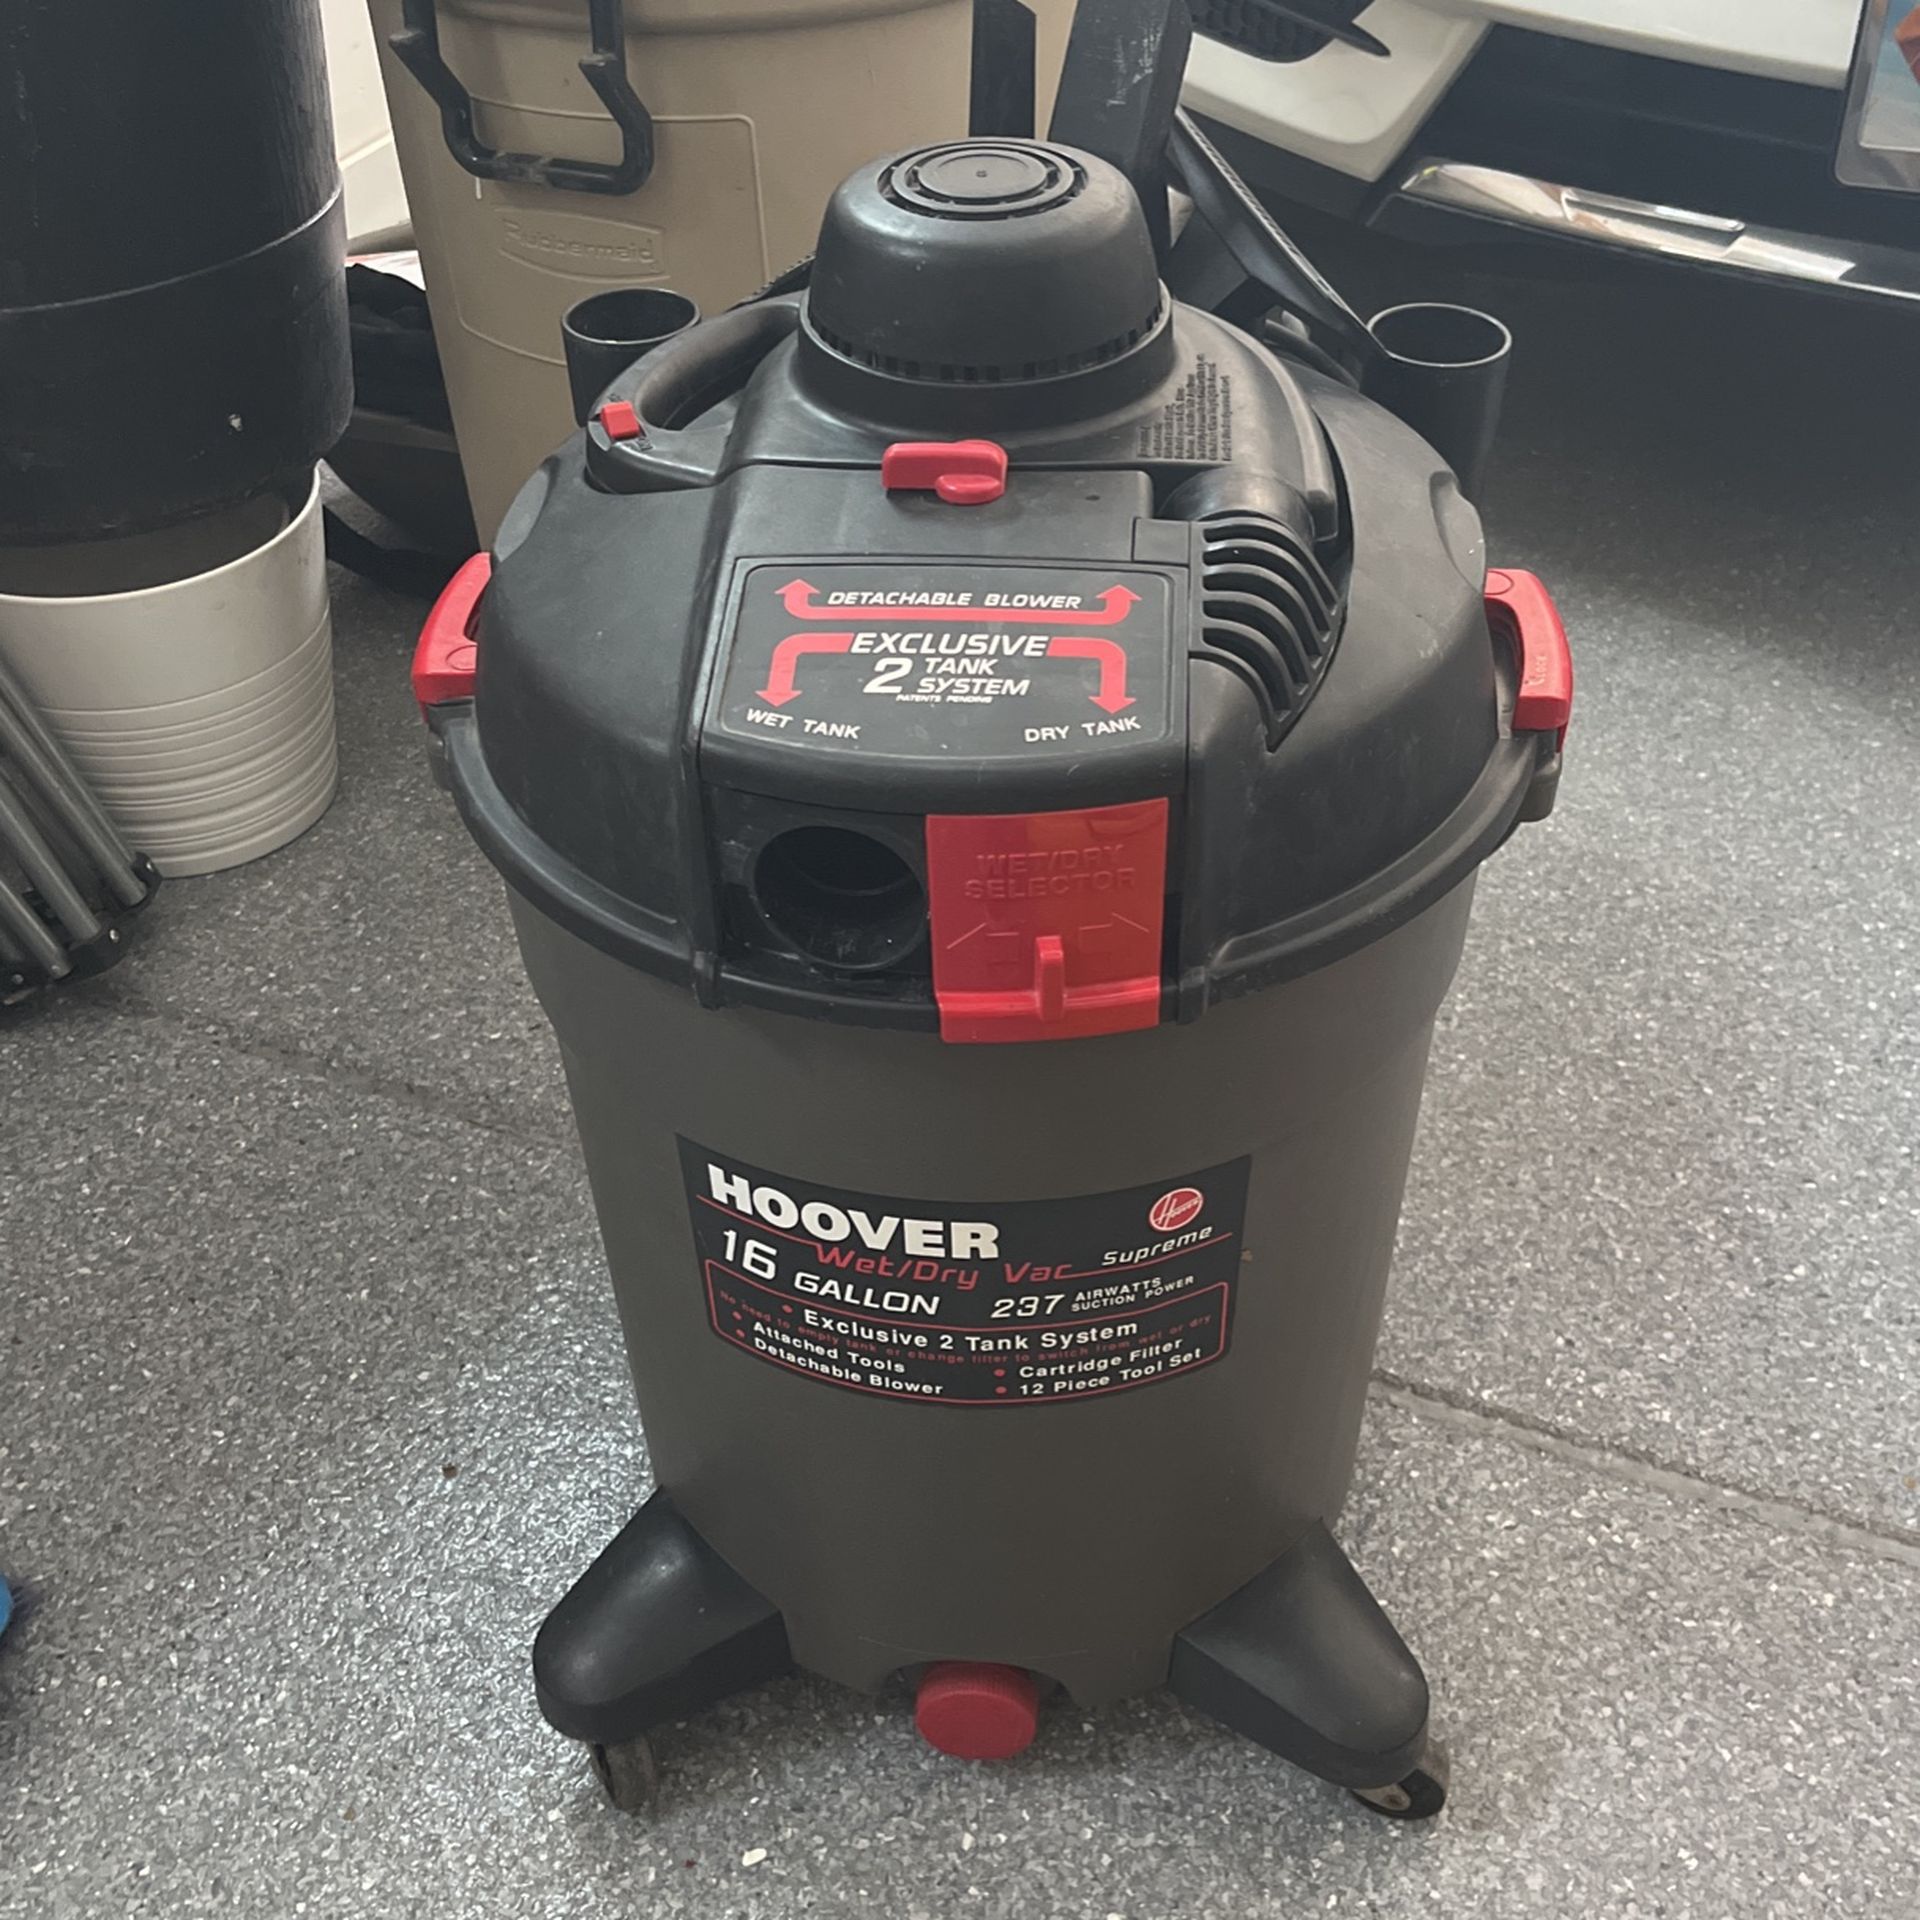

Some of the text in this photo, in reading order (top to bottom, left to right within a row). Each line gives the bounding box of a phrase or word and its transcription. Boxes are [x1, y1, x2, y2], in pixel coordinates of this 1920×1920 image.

[827, 591, 1082, 609] DETACHABLE BLOWER
[850, 632, 1050, 657] EXCLUSIVE
[863, 657, 914, 694] 2
[924, 657, 998, 676] TANK
[917, 678, 1030, 696] SYSTEM
[746, 708, 861, 739] WET TANK
[1024, 717, 1141, 744] DRY TANK
[976, 844, 1125, 876] WET/DRY
[964, 867, 1136, 898] SELECTOR
[708, 1163, 1000, 1259] HOOVER
[723, 1229, 777, 1280] 16
[1101, 1225, 1213, 1265] Supreme
[817, 1246, 1072, 1290] Wet/Dry Vac
[794, 1271, 940, 1315] GALLON
[990, 1294, 1065, 1318] 237
[1071, 1275, 1194, 1312] SUCTION POWER
[1075, 1277, 1161, 1302] AIRWATTS
[753, 1321, 905, 1373] Attached Tools
[804, 1308, 1138, 1351] Exclusive 2 Tank System
[754, 1337, 943, 1395] Detachable Blower
[1019, 1338, 1183, 1379] Cartridge Filter
[1020, 1347, 1201, 1395] 12 Piece Tool Set
